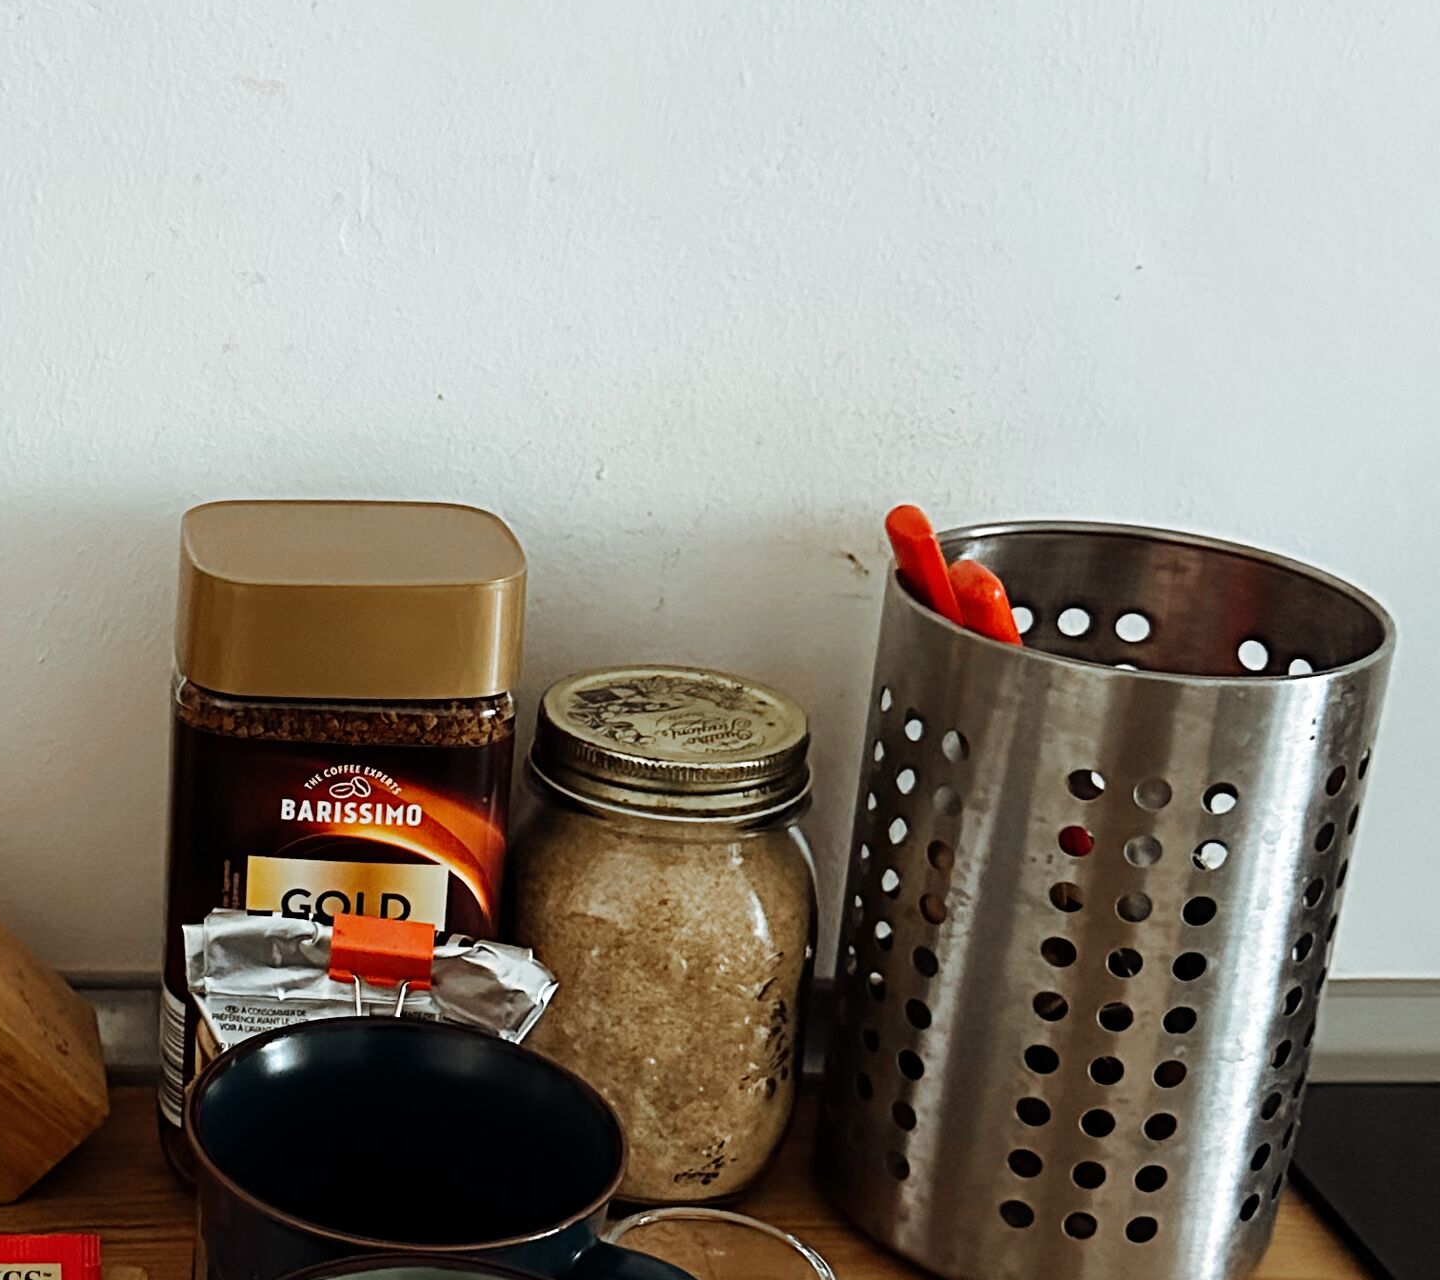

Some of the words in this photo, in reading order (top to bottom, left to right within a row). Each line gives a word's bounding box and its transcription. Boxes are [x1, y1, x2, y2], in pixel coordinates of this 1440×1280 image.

[303, 773, 323, 790] THE
[323, 764, 361, 778] COFFEE
[364, 766, 402, 795] EXPERTS
[280, 798, 423, 827] BARISSIMO
